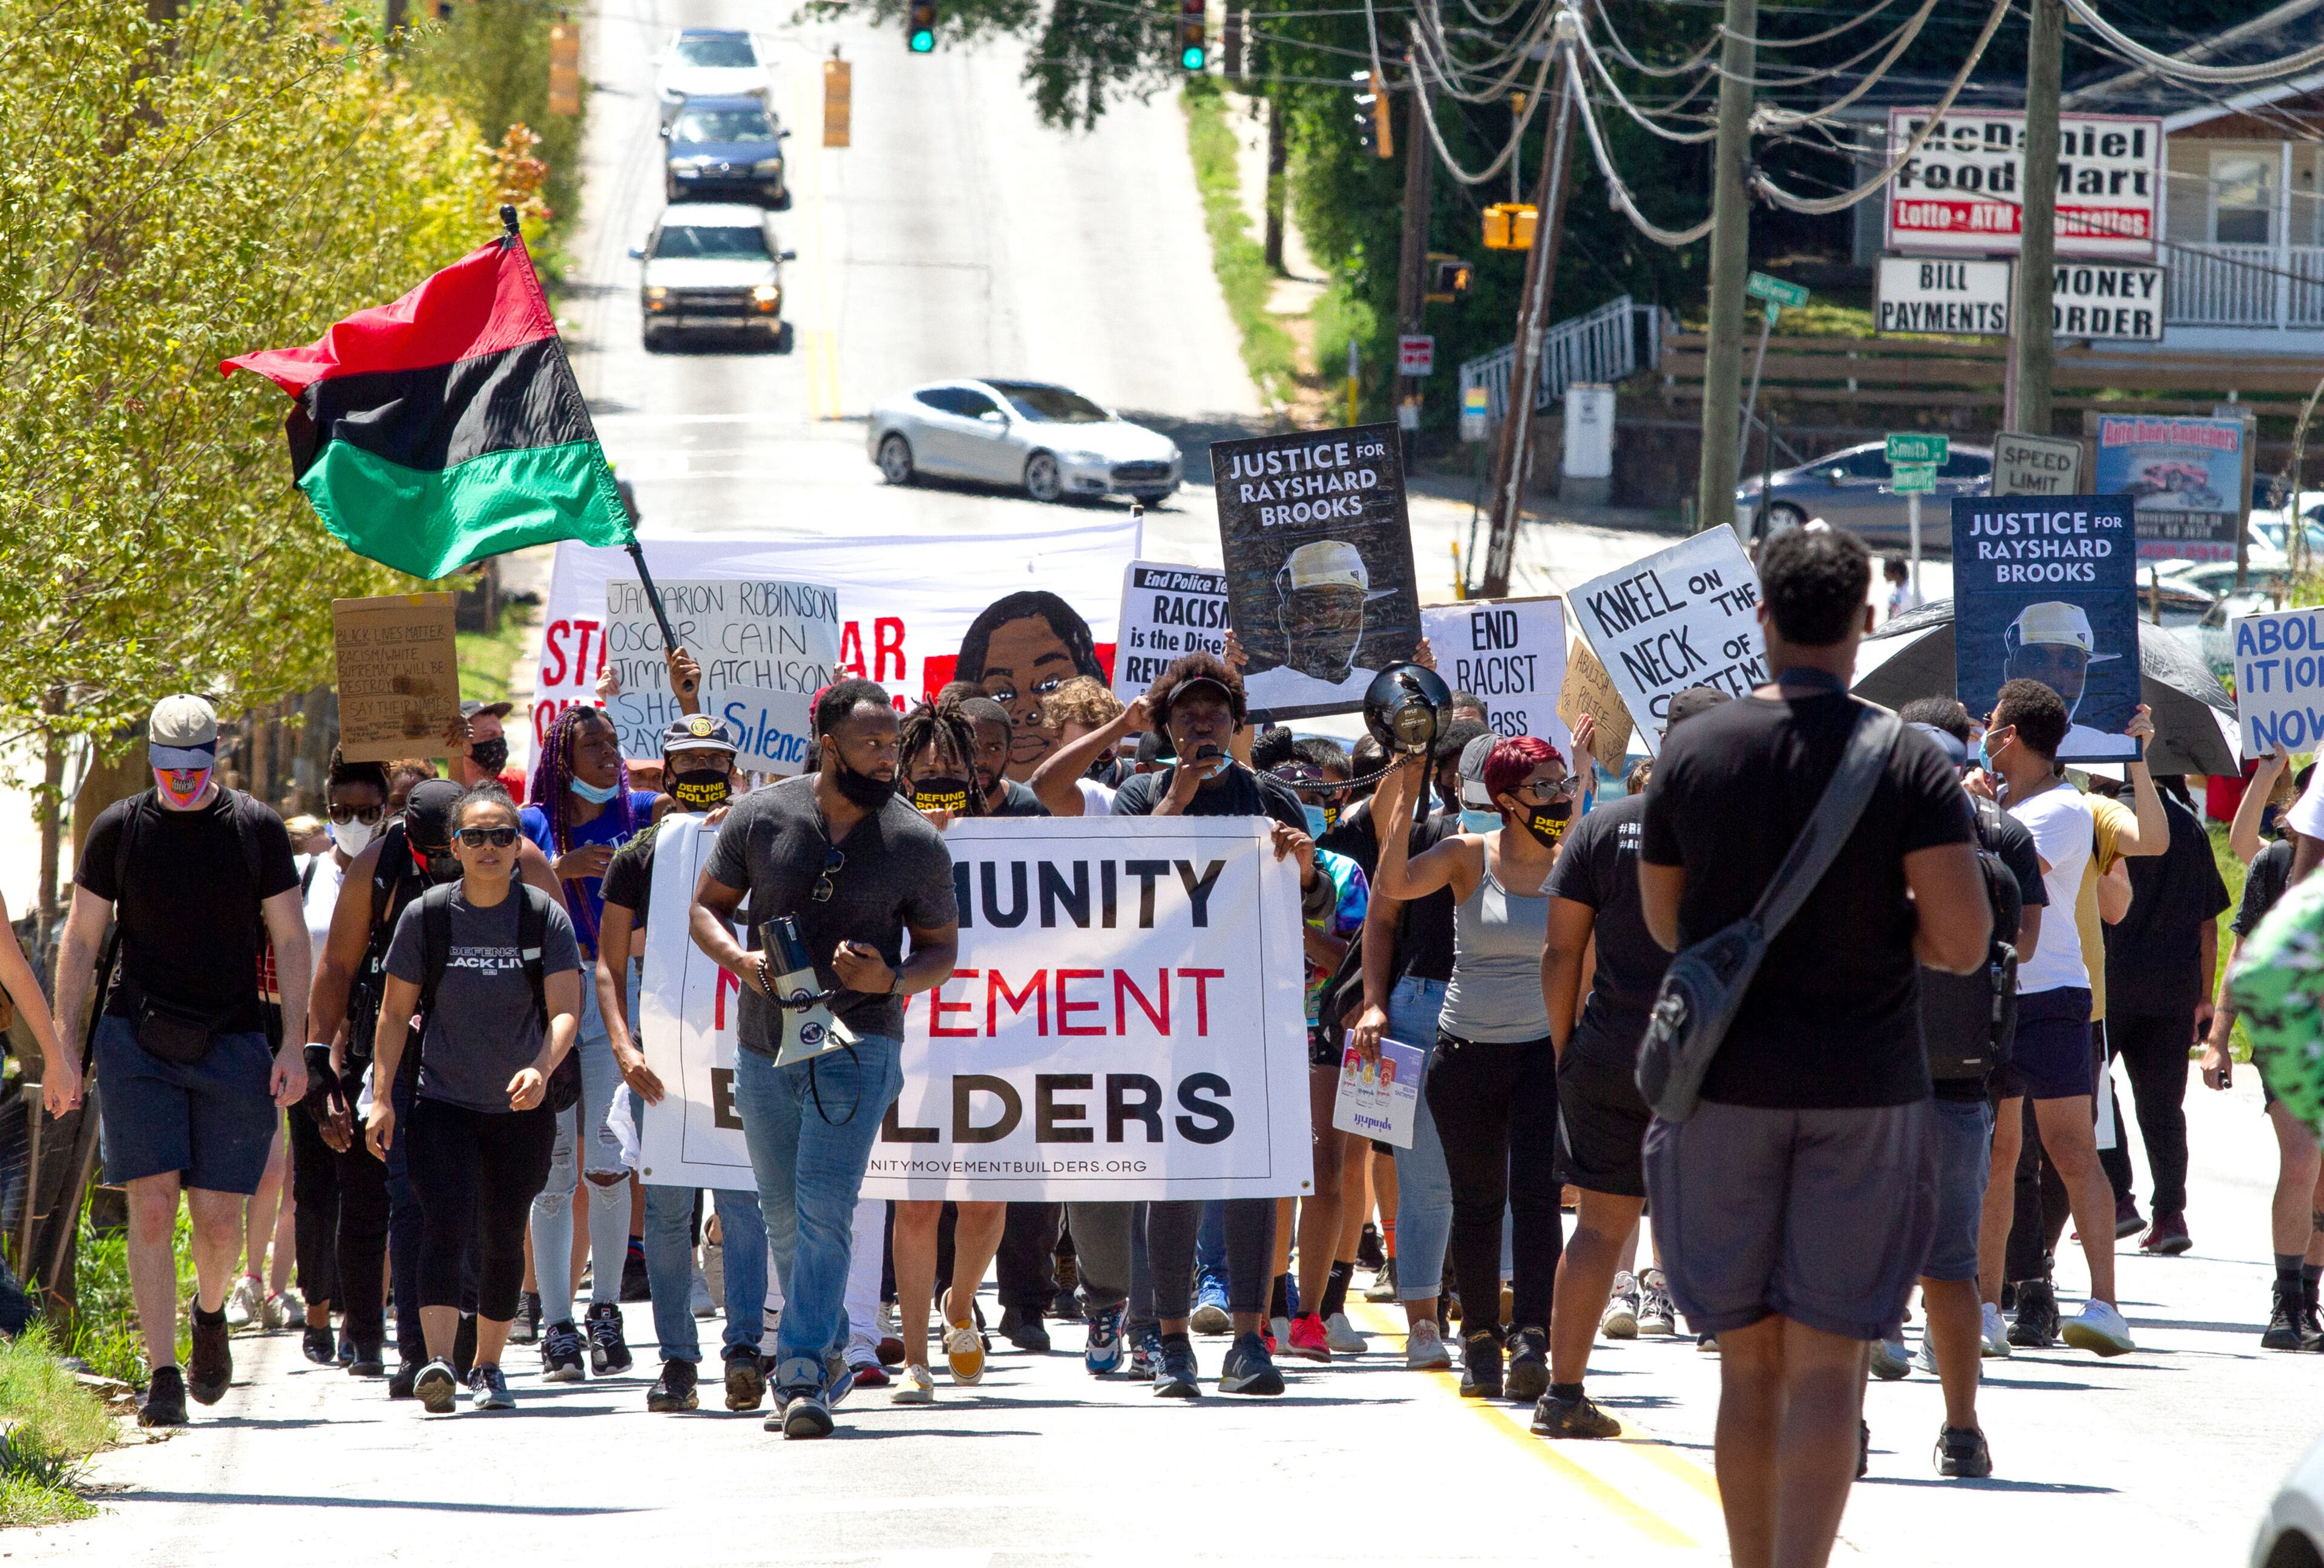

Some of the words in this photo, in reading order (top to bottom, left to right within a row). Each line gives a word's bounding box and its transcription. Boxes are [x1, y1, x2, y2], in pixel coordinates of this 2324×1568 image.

[1909, 119, 2145, 157] McDniel
[1899, 159, 2015, 192] Food
[1899, 201, 1952, 228] Lotto
[1969, 205, 2014, 231] ATM
[2054, 210, 2145, 237] garettes
[1920, 264, 1968, 290] BILL
[1882, 302, 2005, 330] PAYMENTS
[1230, 442, 1350, 479] JUSTICE
[1356, 443, 1385, 458] FOR
[2003, 446, 2070, 471] SPEED
[1240, 469, 1377, 504] RAYSHARD
[2009, 471, 2060, 493] LIMIT
[1261, 495, 1362, 526] BROOKS
[1969, 512, 2087, 536] JUSTICE
[2095, 517, 2123, 528] FOR
[1978, 539, 2112, 559] RAYSHARD
[1144, 571, 1169, 587] End
[1170, 574, 1212, 592] Police
[1997, 563, 2095, 583] BROOKS
[740, 582, 838, 624] ROBINSON
[1586, 569, 1688, 639] KNEEL
[1688, 569, 1723, 594] ON
[1710, 582, 1757, 617] THE
[336, 629, 369, 644] BLACK
[375, 627, 402, 641] LIVES
[405, 625, 445, 639] MATTER
[722, 623, 807, 655] CAIN
[1130, 627, 1145, 648] is
[1150, 629, 1180, 651] the
[1471, 609, 1518, 651] END
[338, 648, 419, 663] RACISM/WHITE
[338, 664, 399, 678] SUPREMACY
[403, 663, 427, 676] WILL
[430, 661, 445, 674] BE
[1125, 656, 1169, 684] REV
[1620, 625, 1708, 695] NECK
[1722, 633, 1751, 659] OF
[611, 657, 669, 689] JIMM
[1456, 654, 1538, 696] RACIST
[349, 701, 373, 717] SAY
[377, 700, 410, 714] THEIR
[414, 697, 451, 713] NAMES
[1483, 701, 1528, 738] ass
[1575, 686, 1610, 730] POLICE
[615, 724, 666, 759] RAY
[724, 702, 810, 764] Silenc
[676, 790, 726, 802] POLICE
[677, 782, 724, 793] DEFUND
[916, 791, 966, 802] DEFUND
[956, 860, 1227, 929] UNITY
[1354, 1113, 1392, 1133] spindrift
[870, 1160, 1147, 1173] NITYMOVEMENTBUILDERS.ORG
